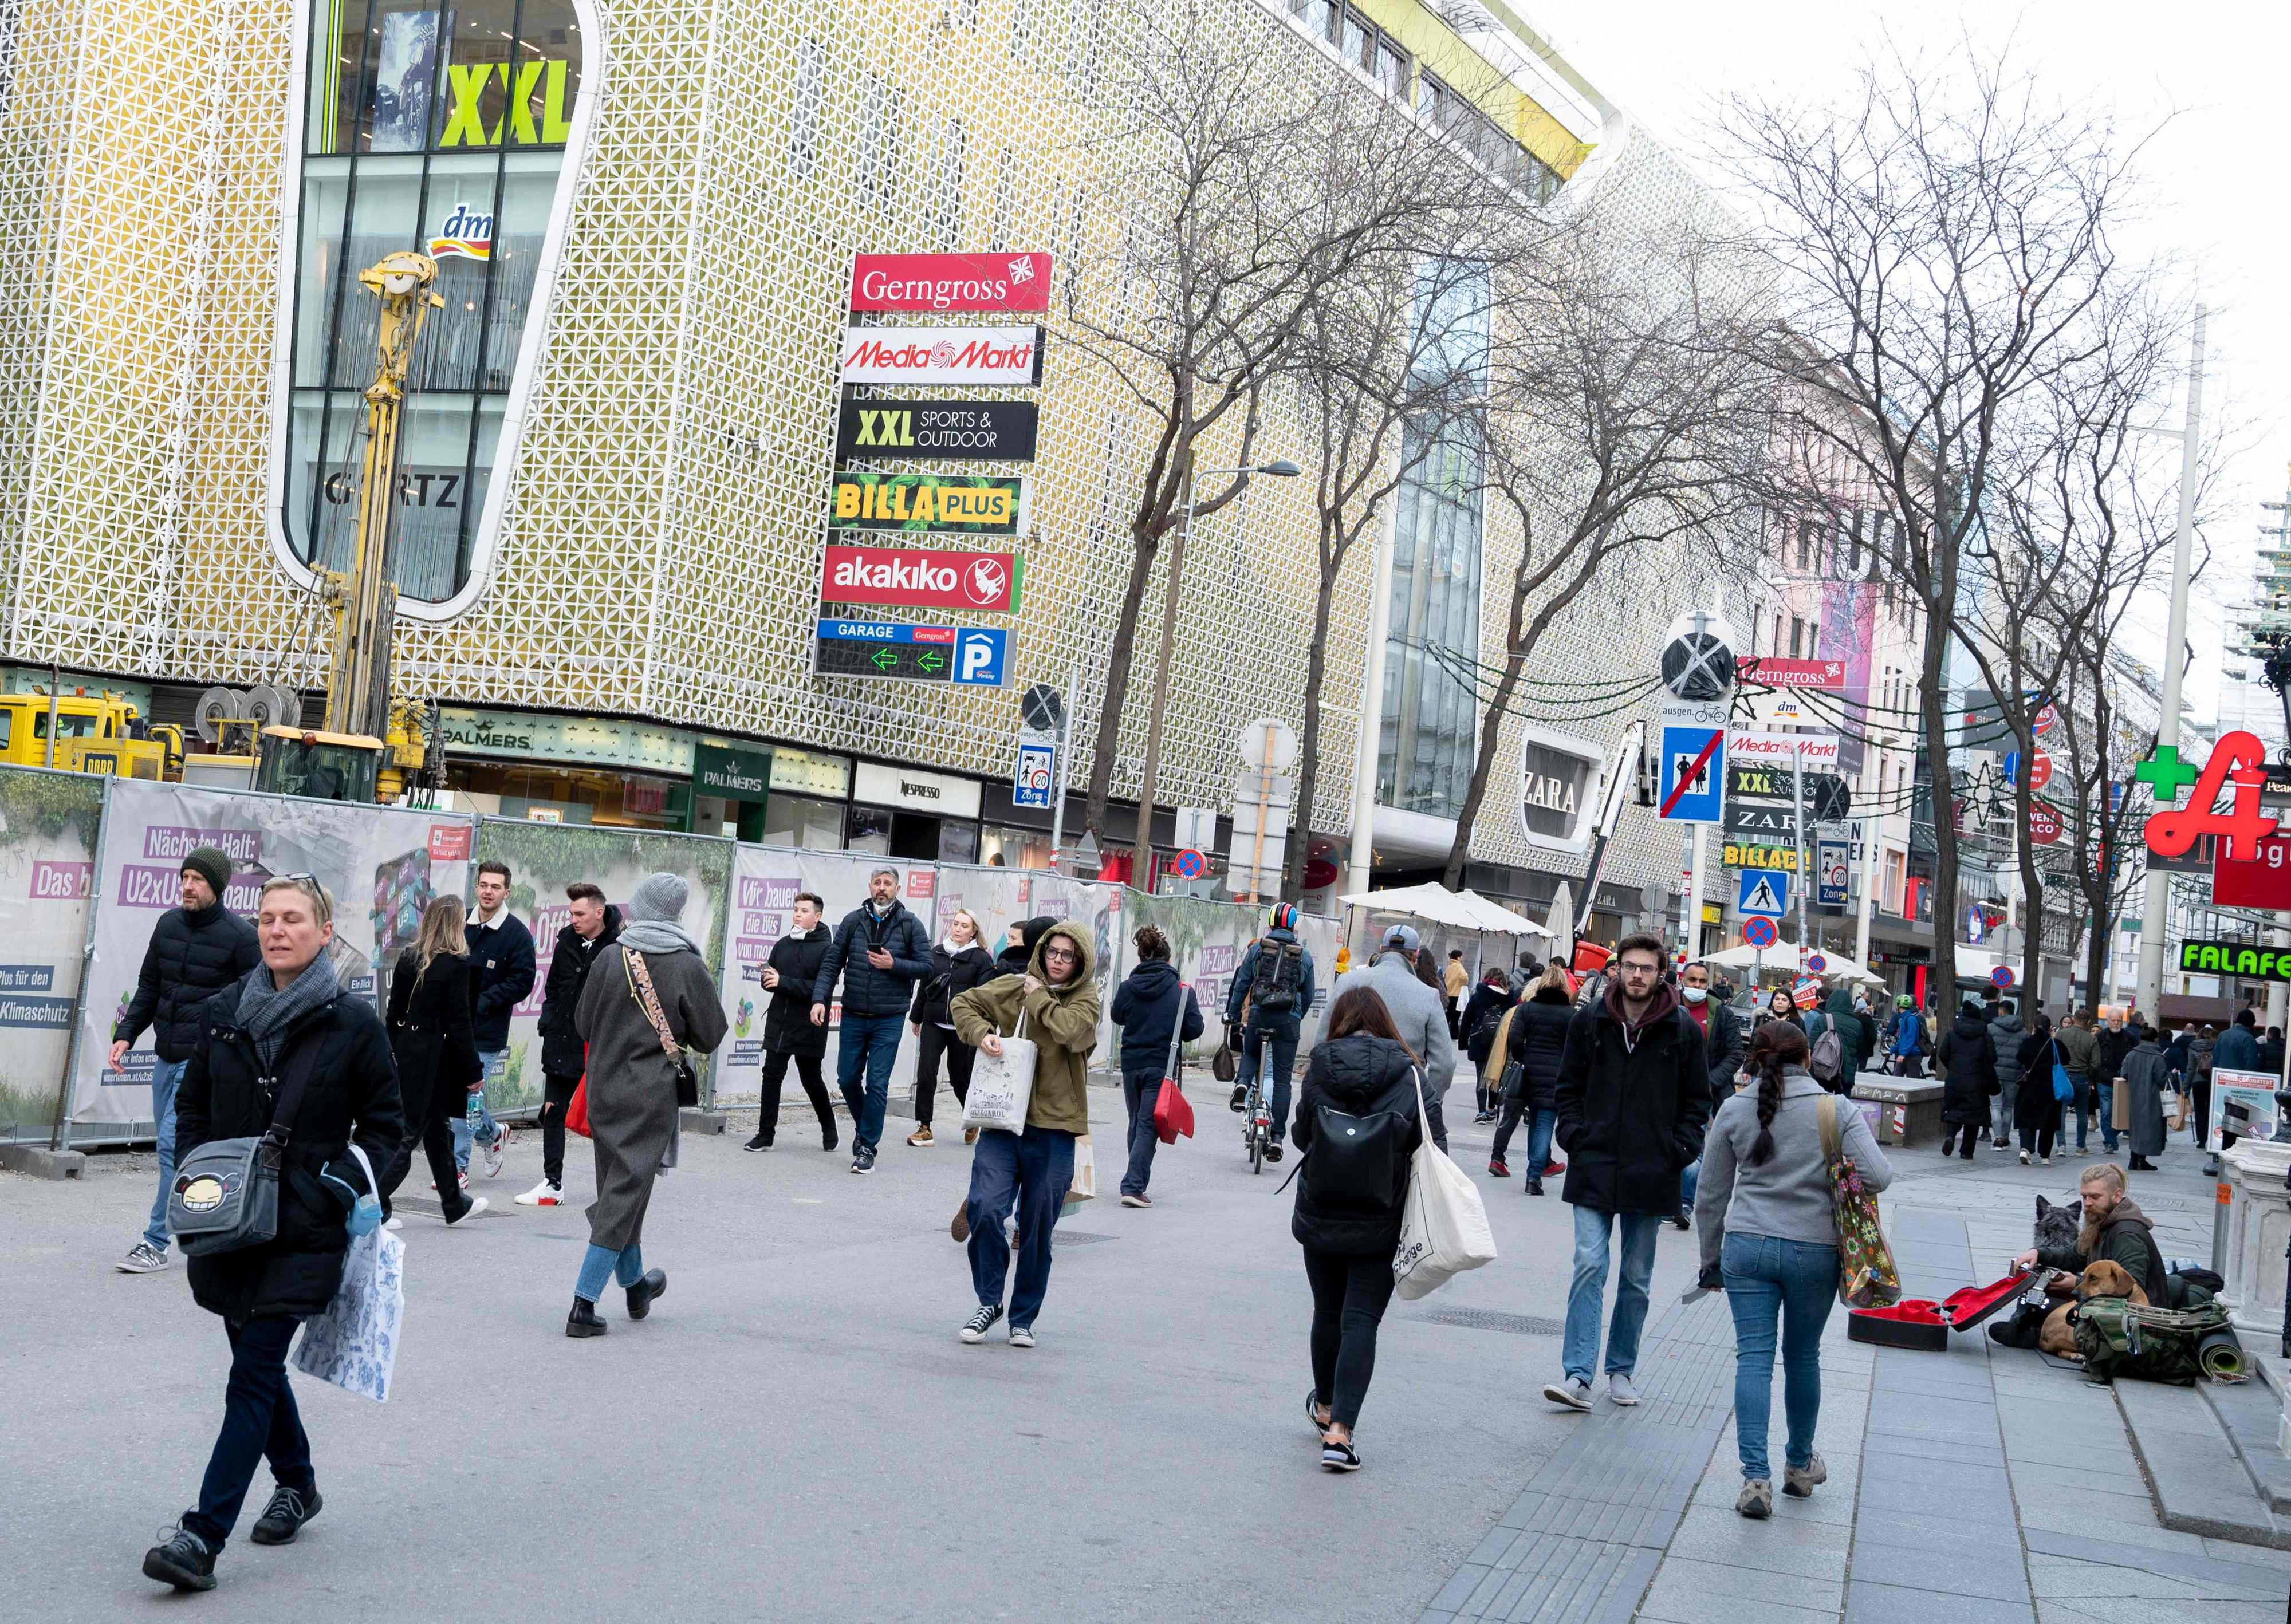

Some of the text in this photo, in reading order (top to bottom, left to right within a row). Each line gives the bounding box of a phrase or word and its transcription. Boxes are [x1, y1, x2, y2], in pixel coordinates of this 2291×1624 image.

[439, 60, 570, 147] XXL
[444, 206, 492, 239] dm
[863, 271, 1007, 308] Gerngross
[844, 340, 1031, 369] Media Markt
[855, 410, 991, 446] XXL SPORTS &
[918, 431, 997, 448] OUTDOOR
[325, 471, 459, 508] GRTZ
[836, 483, 1005, 521] BILLA PLUS
[834, 556, 958, 592] akakiko
[837, 624, 945, 642] GARAGE Gerngross
[962, 644, 993, 680] P
[1742, 667, 1825, 687] Gerngross
[1663, 708, 1694, 717] ausgen.
[1778, 701, 1797, 712] dm
[443, 731, 530, 750] PALMERS
[1729, 737, 1780, 754] Media
[1797, 741, 1837, 756] Markt
[704, 771, 762, 793] PALMERS
[900, 779, 940, 799] NESPRESSO
[1036, 775, 1046, 786] 20
[1737, 772, 1772, 793] XXL
[1524, 770, 1576, 814] ZARA
[2037, 824, 2054, 833] CO
[1725, 845, 1781, 869] BILLA
[37, 865, 73, 897] Das
[399, 862, 410, 880] U2
[1836, 872, 1845, 883] 20
[375, 882, 383, 897] U2
[398, 890, 408, 905] U5
[743, 879, 798, 908] Wir bauen
[1597, 894, 1616, 907] ZARA
[397, 909, 408, 928] U5
[746, 913, 760, 933] die
[382, 930, 392, 948] U2
[738, 943, 752, 959] von
[15, 971, 29, 986] für
[31, 972, 49, 986] den
[351, 979, 360, 990] Ein
[0, 1001, 69, 1022] Klimaschutz
[120, 1054, 130, 1063] ehr
[1393, 1242, 1423, 1273] change
